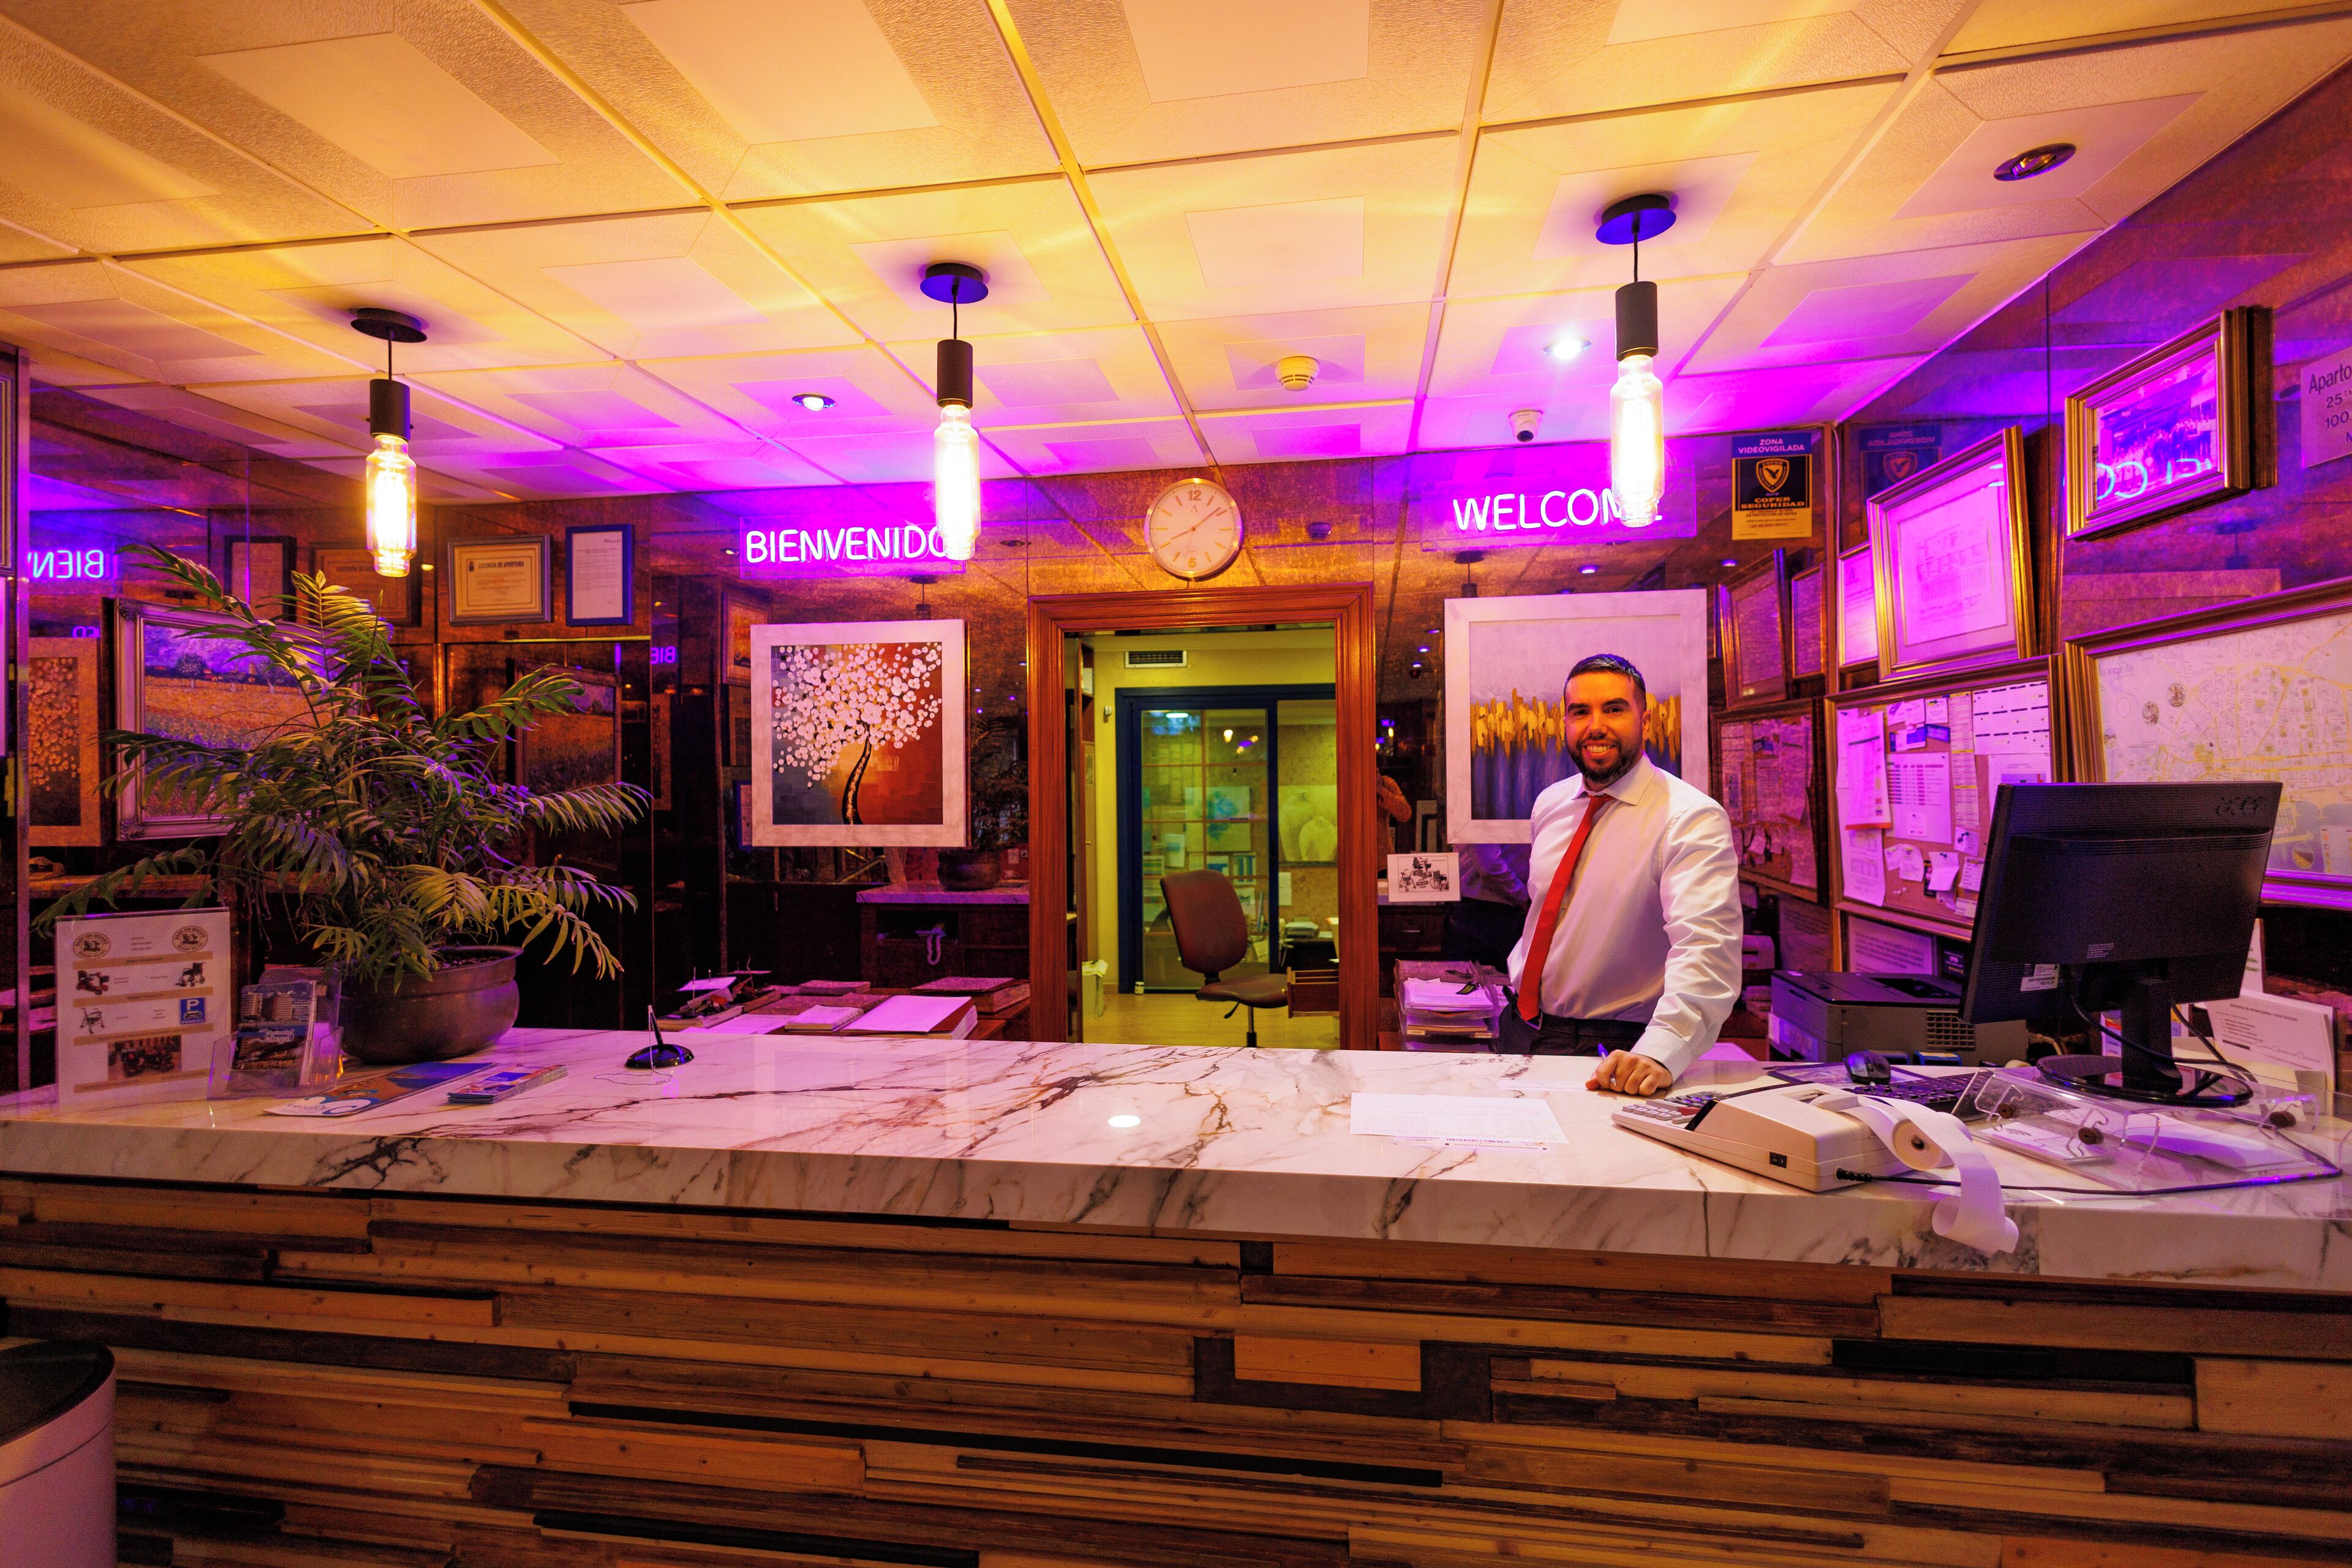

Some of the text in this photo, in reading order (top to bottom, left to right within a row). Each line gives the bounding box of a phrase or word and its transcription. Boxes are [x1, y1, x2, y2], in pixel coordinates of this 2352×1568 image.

[1738, 444, 1805, 453] VIDEOVIGILADA
[1188, 489, 1202, 501] 12
[1453, 488, 1662, 532] WELCOM
[1741, 501, 1805, 510] SEGURIDAD
[1188, 557, 1196, 568] 6
[186, 999, 200, 1011] P
